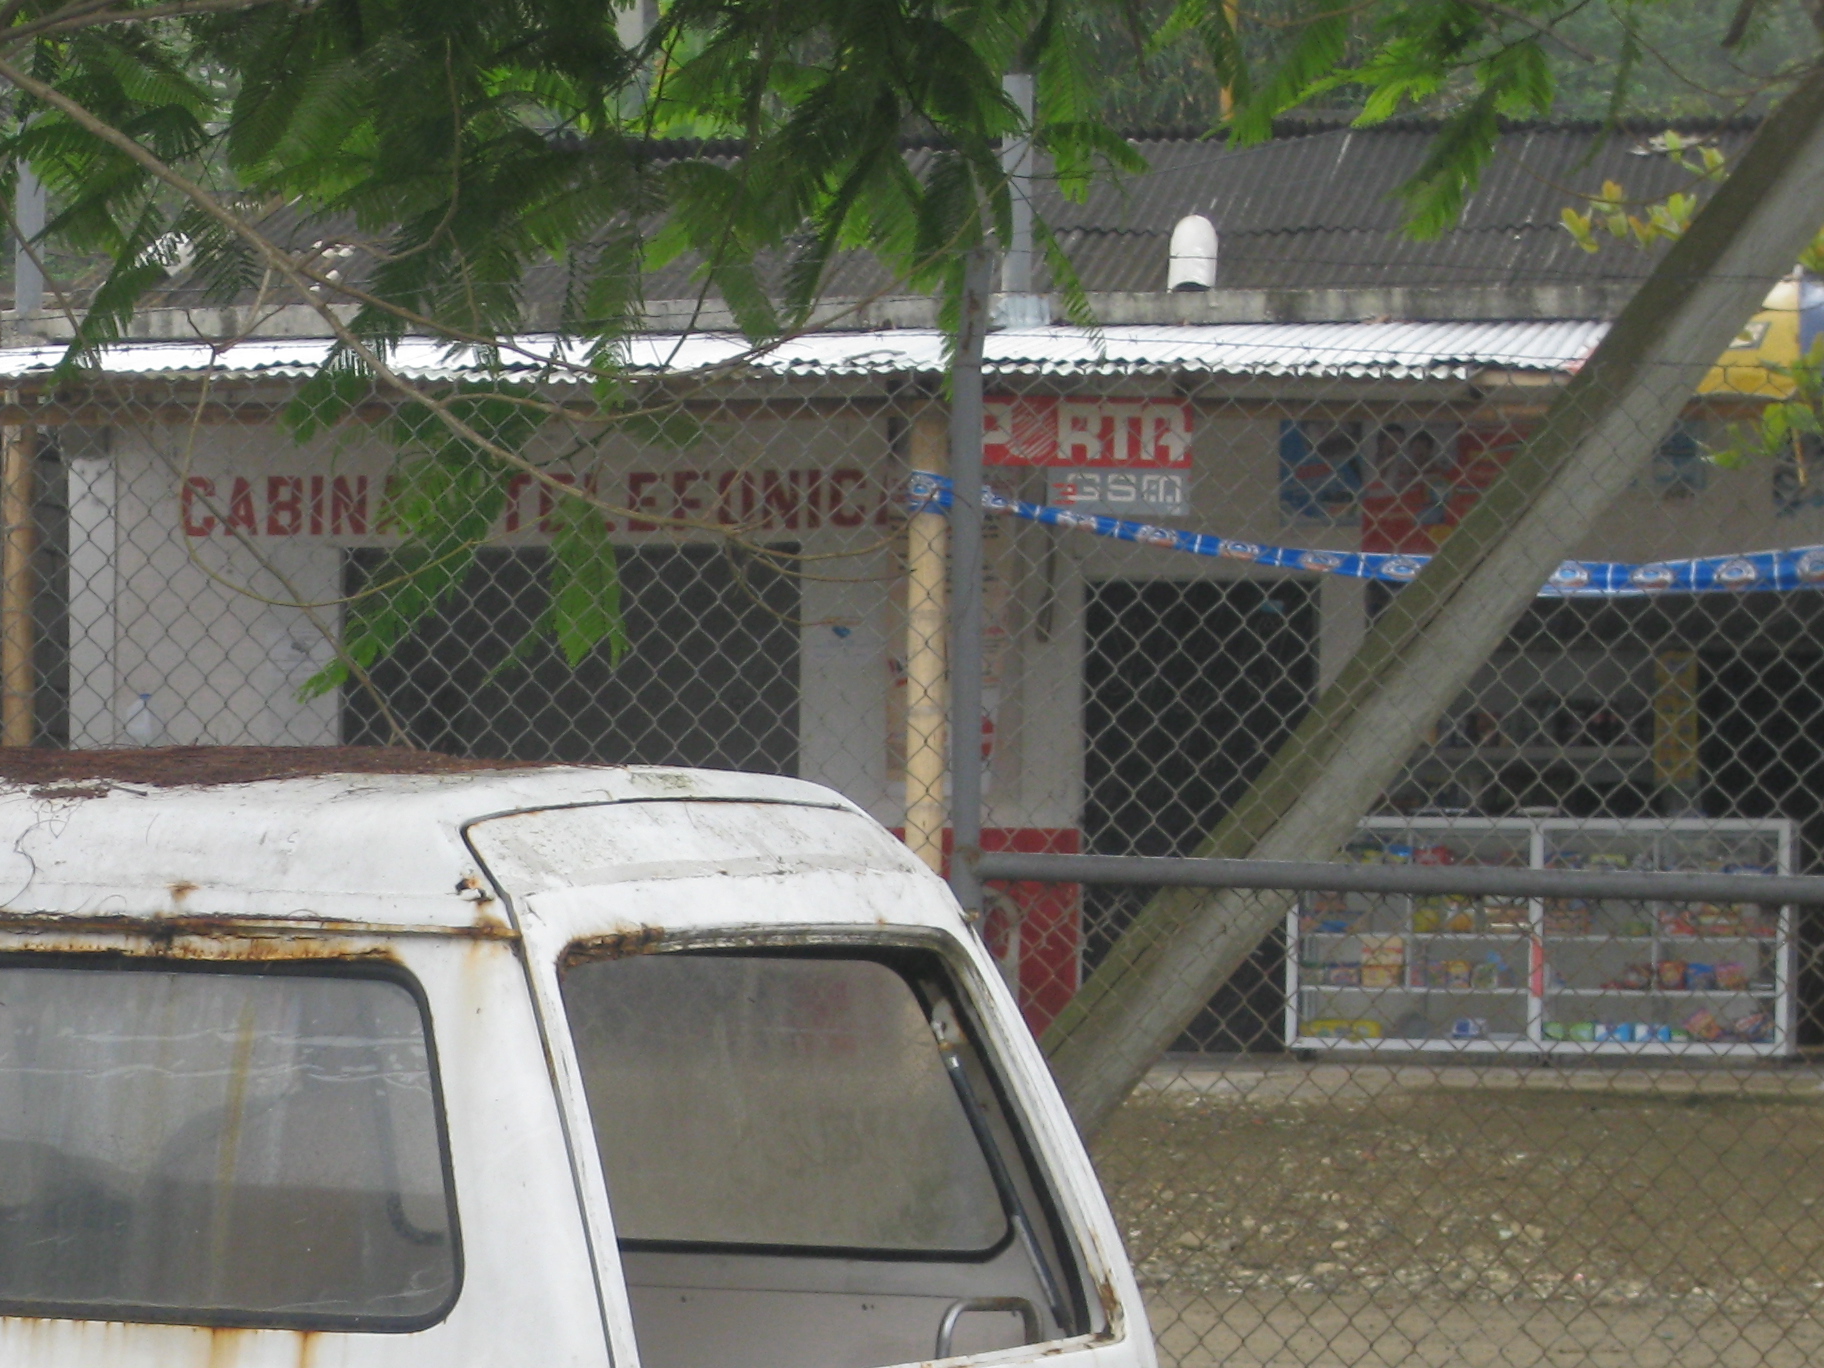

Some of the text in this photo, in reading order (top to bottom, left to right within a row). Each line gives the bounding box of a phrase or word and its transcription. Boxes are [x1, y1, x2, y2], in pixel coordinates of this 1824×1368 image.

[180, 474, 414, 537] CABINA
[505, 469, 901, 532] TELEFONIC
[1065, 472, 1183, 503] GSM
